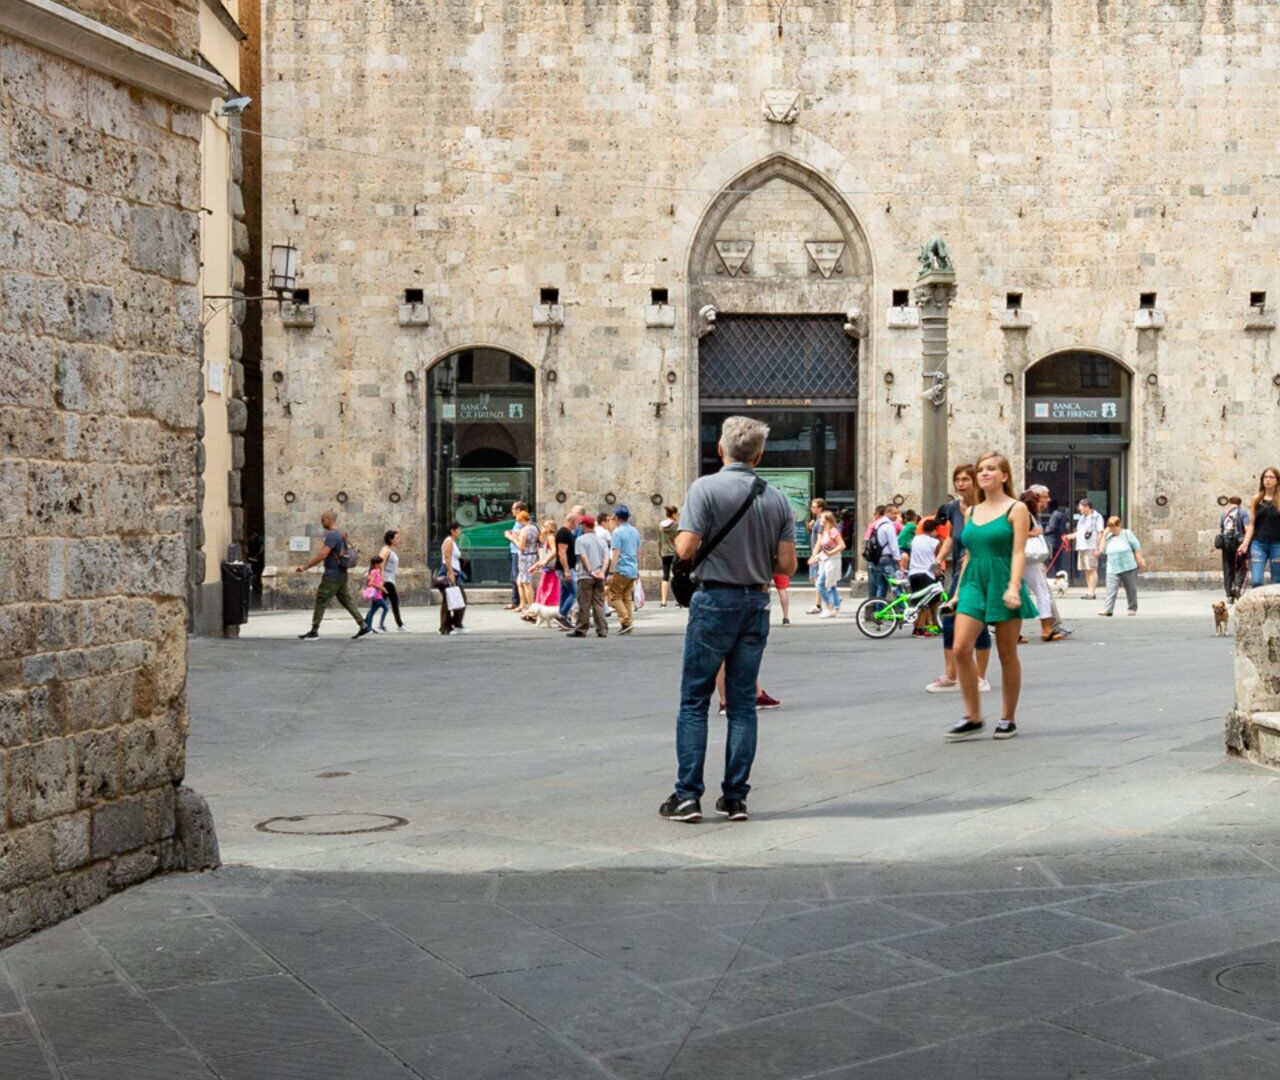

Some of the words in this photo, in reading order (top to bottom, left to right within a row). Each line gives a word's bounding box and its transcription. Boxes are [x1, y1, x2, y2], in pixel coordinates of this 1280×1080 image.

[460, 403, 488, 411] BANCA
[474, 411, 504, 419] FIRENZE
[1052, 410, 1065, 418] CR
[1067, 410, 1098, 418] FIRENZE
[1037, 460, 1058, 472] ore
